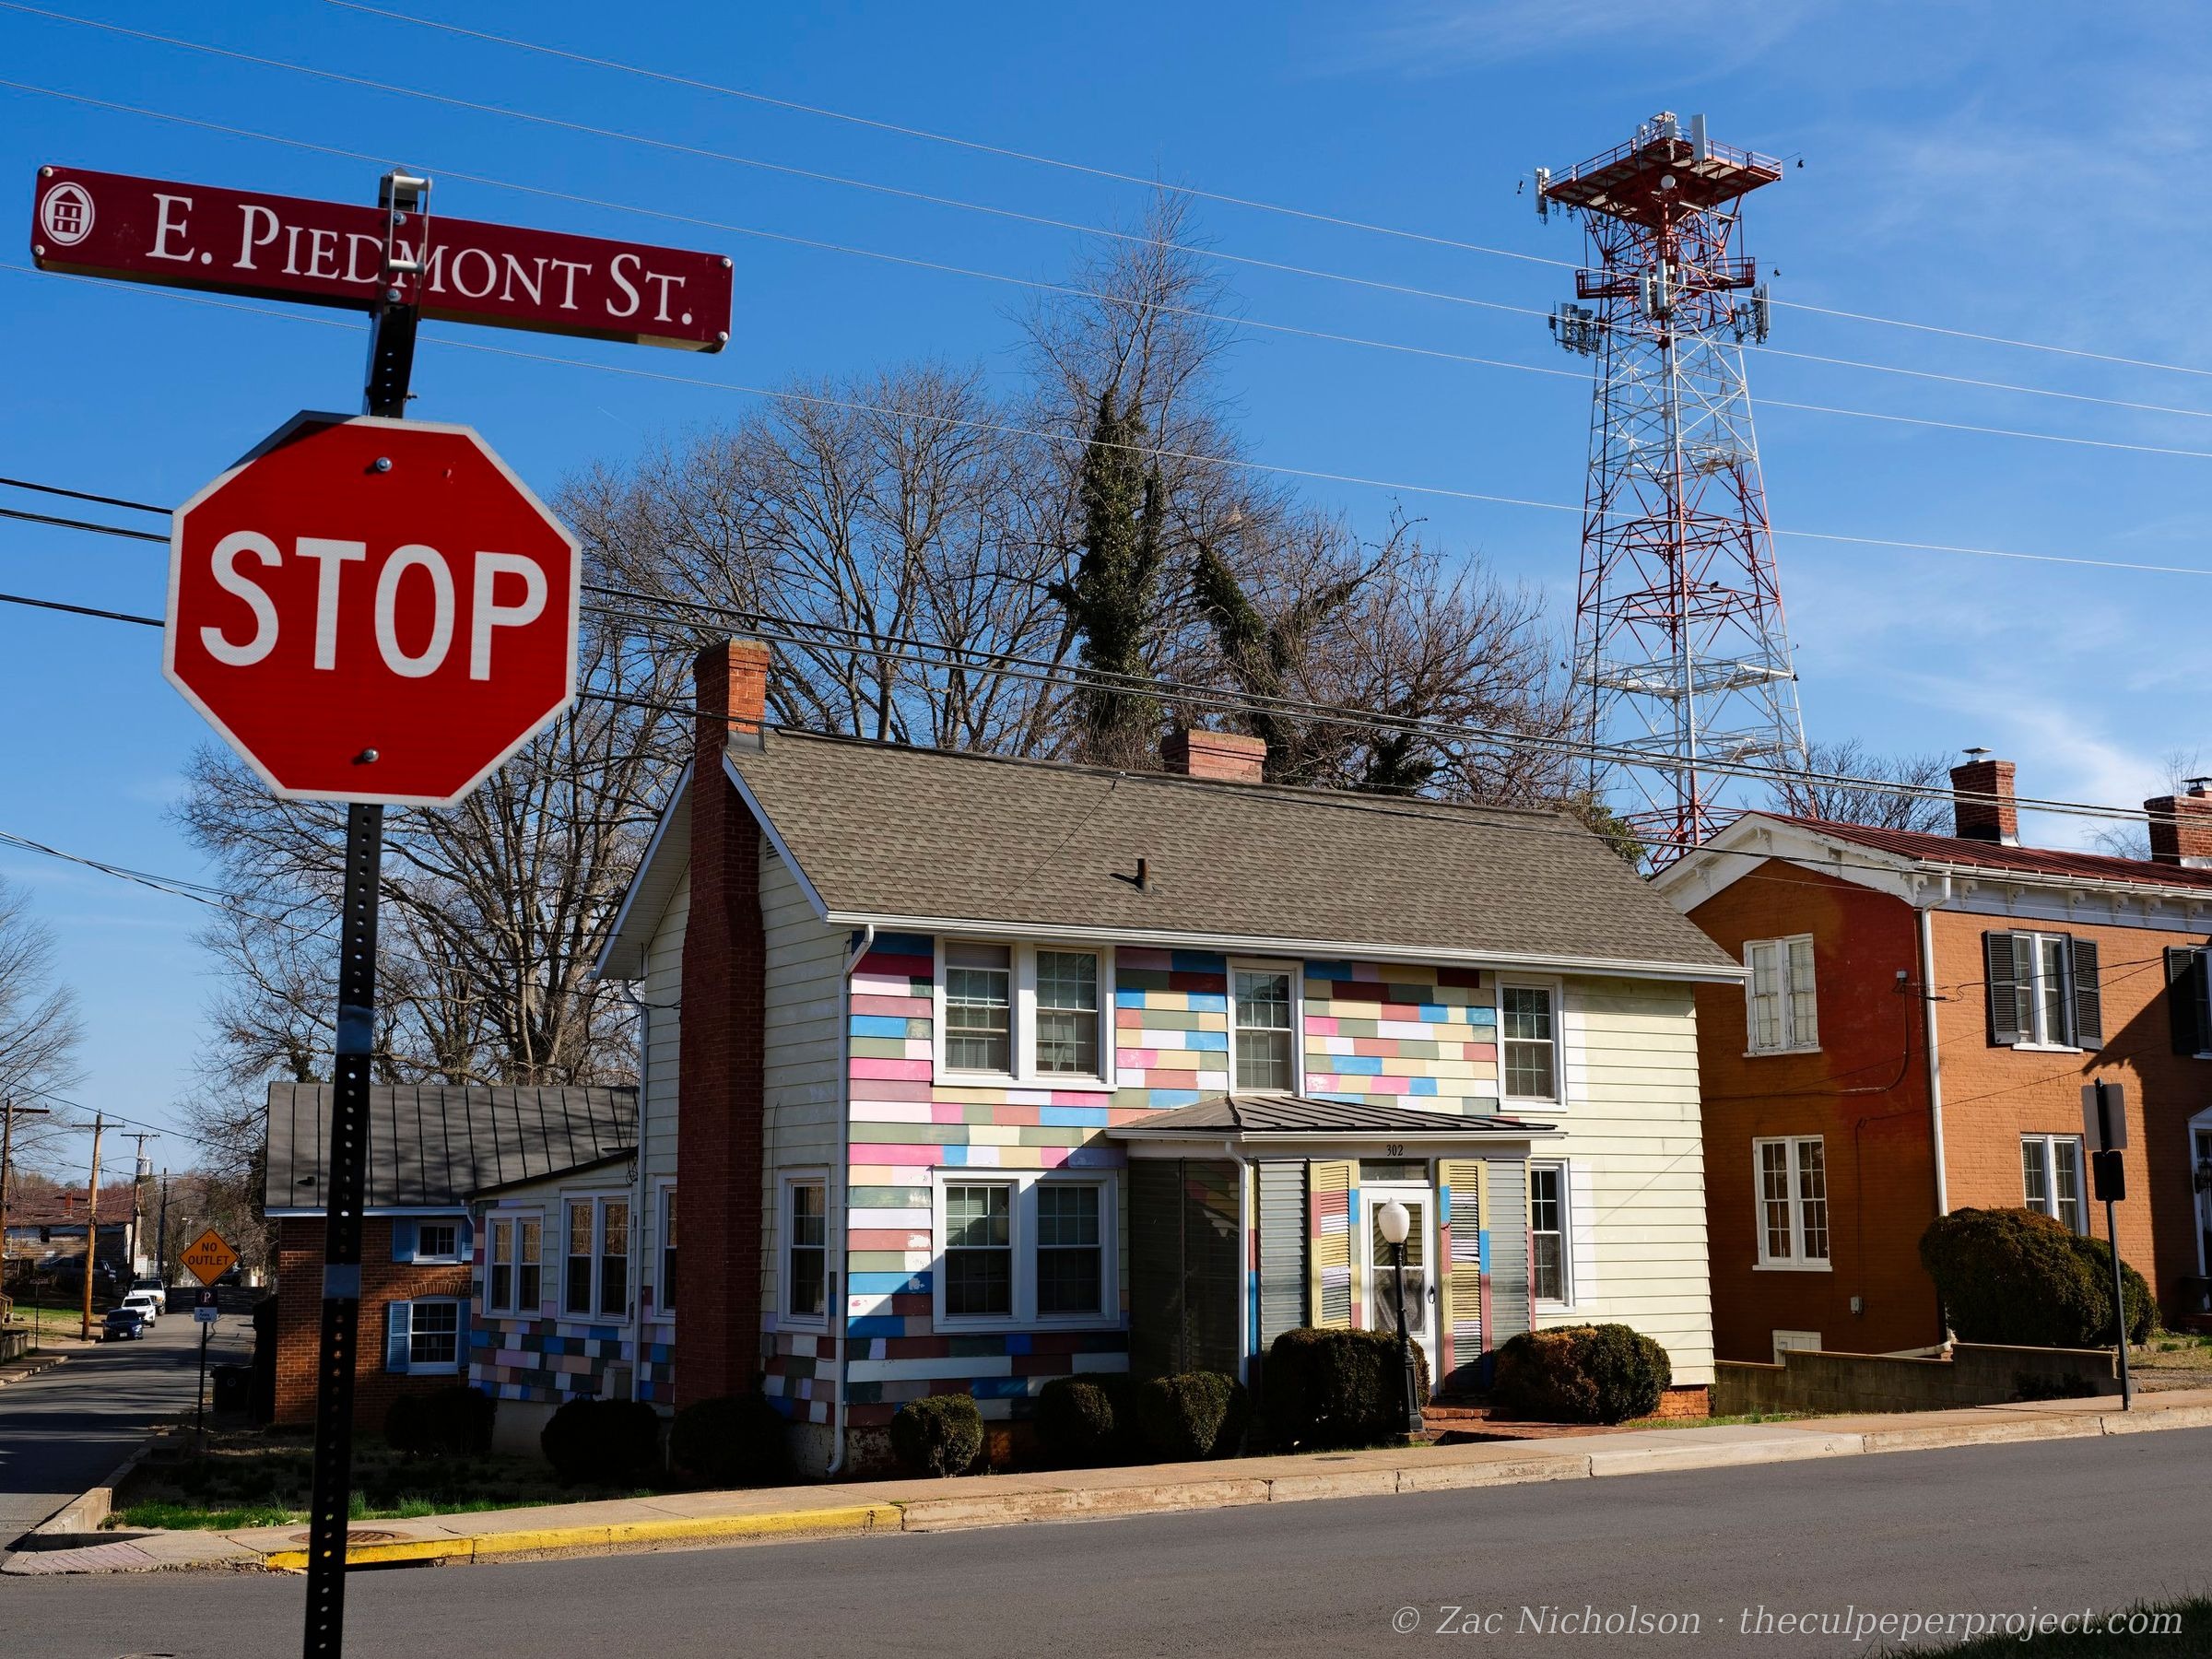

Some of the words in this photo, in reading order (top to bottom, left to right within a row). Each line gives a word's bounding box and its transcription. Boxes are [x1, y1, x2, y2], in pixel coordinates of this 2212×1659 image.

[145, 193, 212, 265] E.
[200, 530, 548, 681] STOP
[1386, 1144, 1404, 1157] 302
[201, 1241, 218, 1253] NO
[187, 1255, 229, 1265] OUTLET
